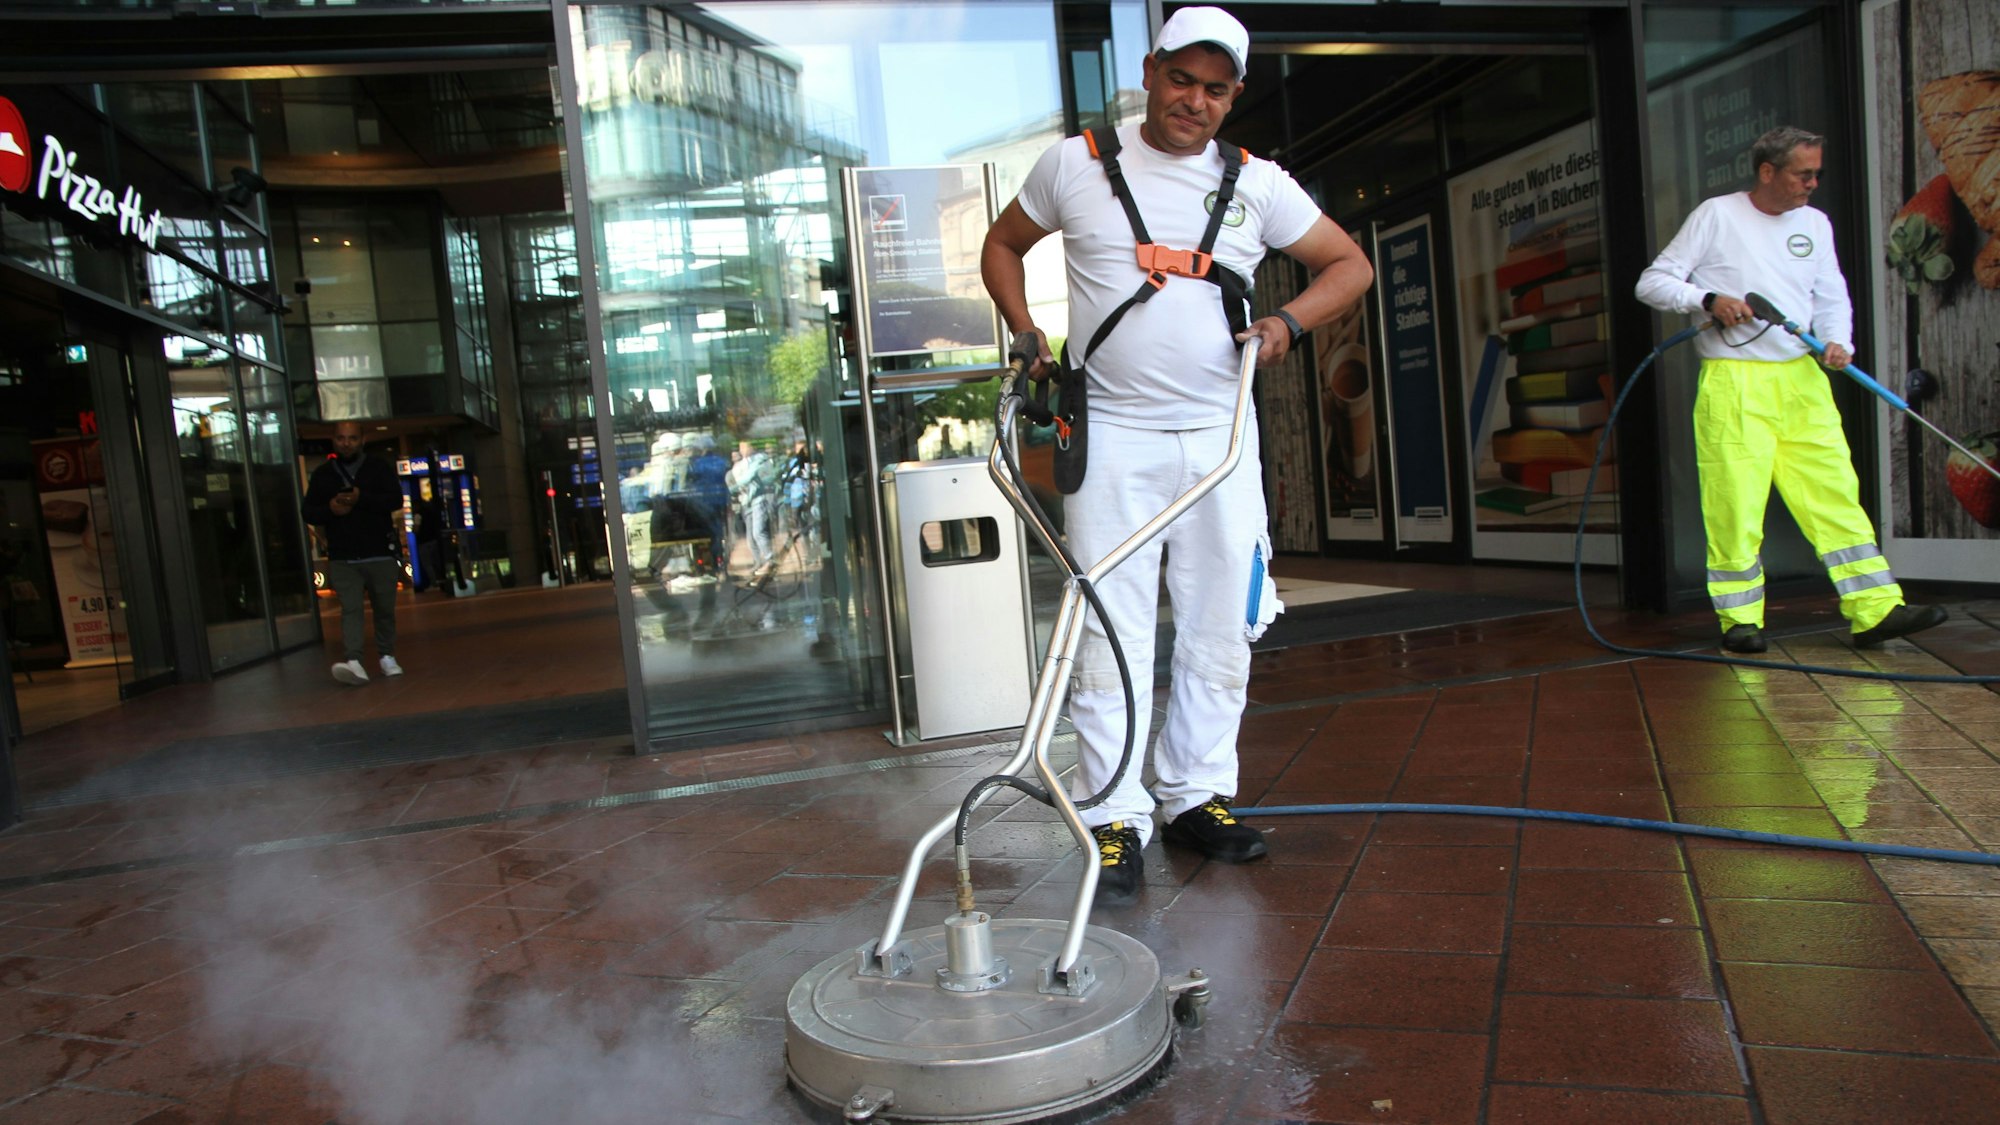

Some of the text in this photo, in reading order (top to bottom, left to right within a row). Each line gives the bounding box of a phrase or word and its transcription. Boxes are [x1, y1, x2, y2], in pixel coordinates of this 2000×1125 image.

[1703, 88, 1750, 120] Wenn
[1705, 127, 1730, 155] Sie
[1707, 149, 1754, 188] am Gl
[38, 134, 163, 250] Pizza Hut
[1471, 188, 1491, 212] Alle
[1493, 178, 1525, 208] guten
[1526, 163, 1562, 190] Worte
[1498, 202, 1535, 229] stehen
[1537, 195, 1549, 215] in
[873, 240, 914, 248] Rauchfreier
[1391, 240, 1418, 262] Immer
[1393, 266, 1407, 284] die
[1394, 285, 1427, 308] richtige
